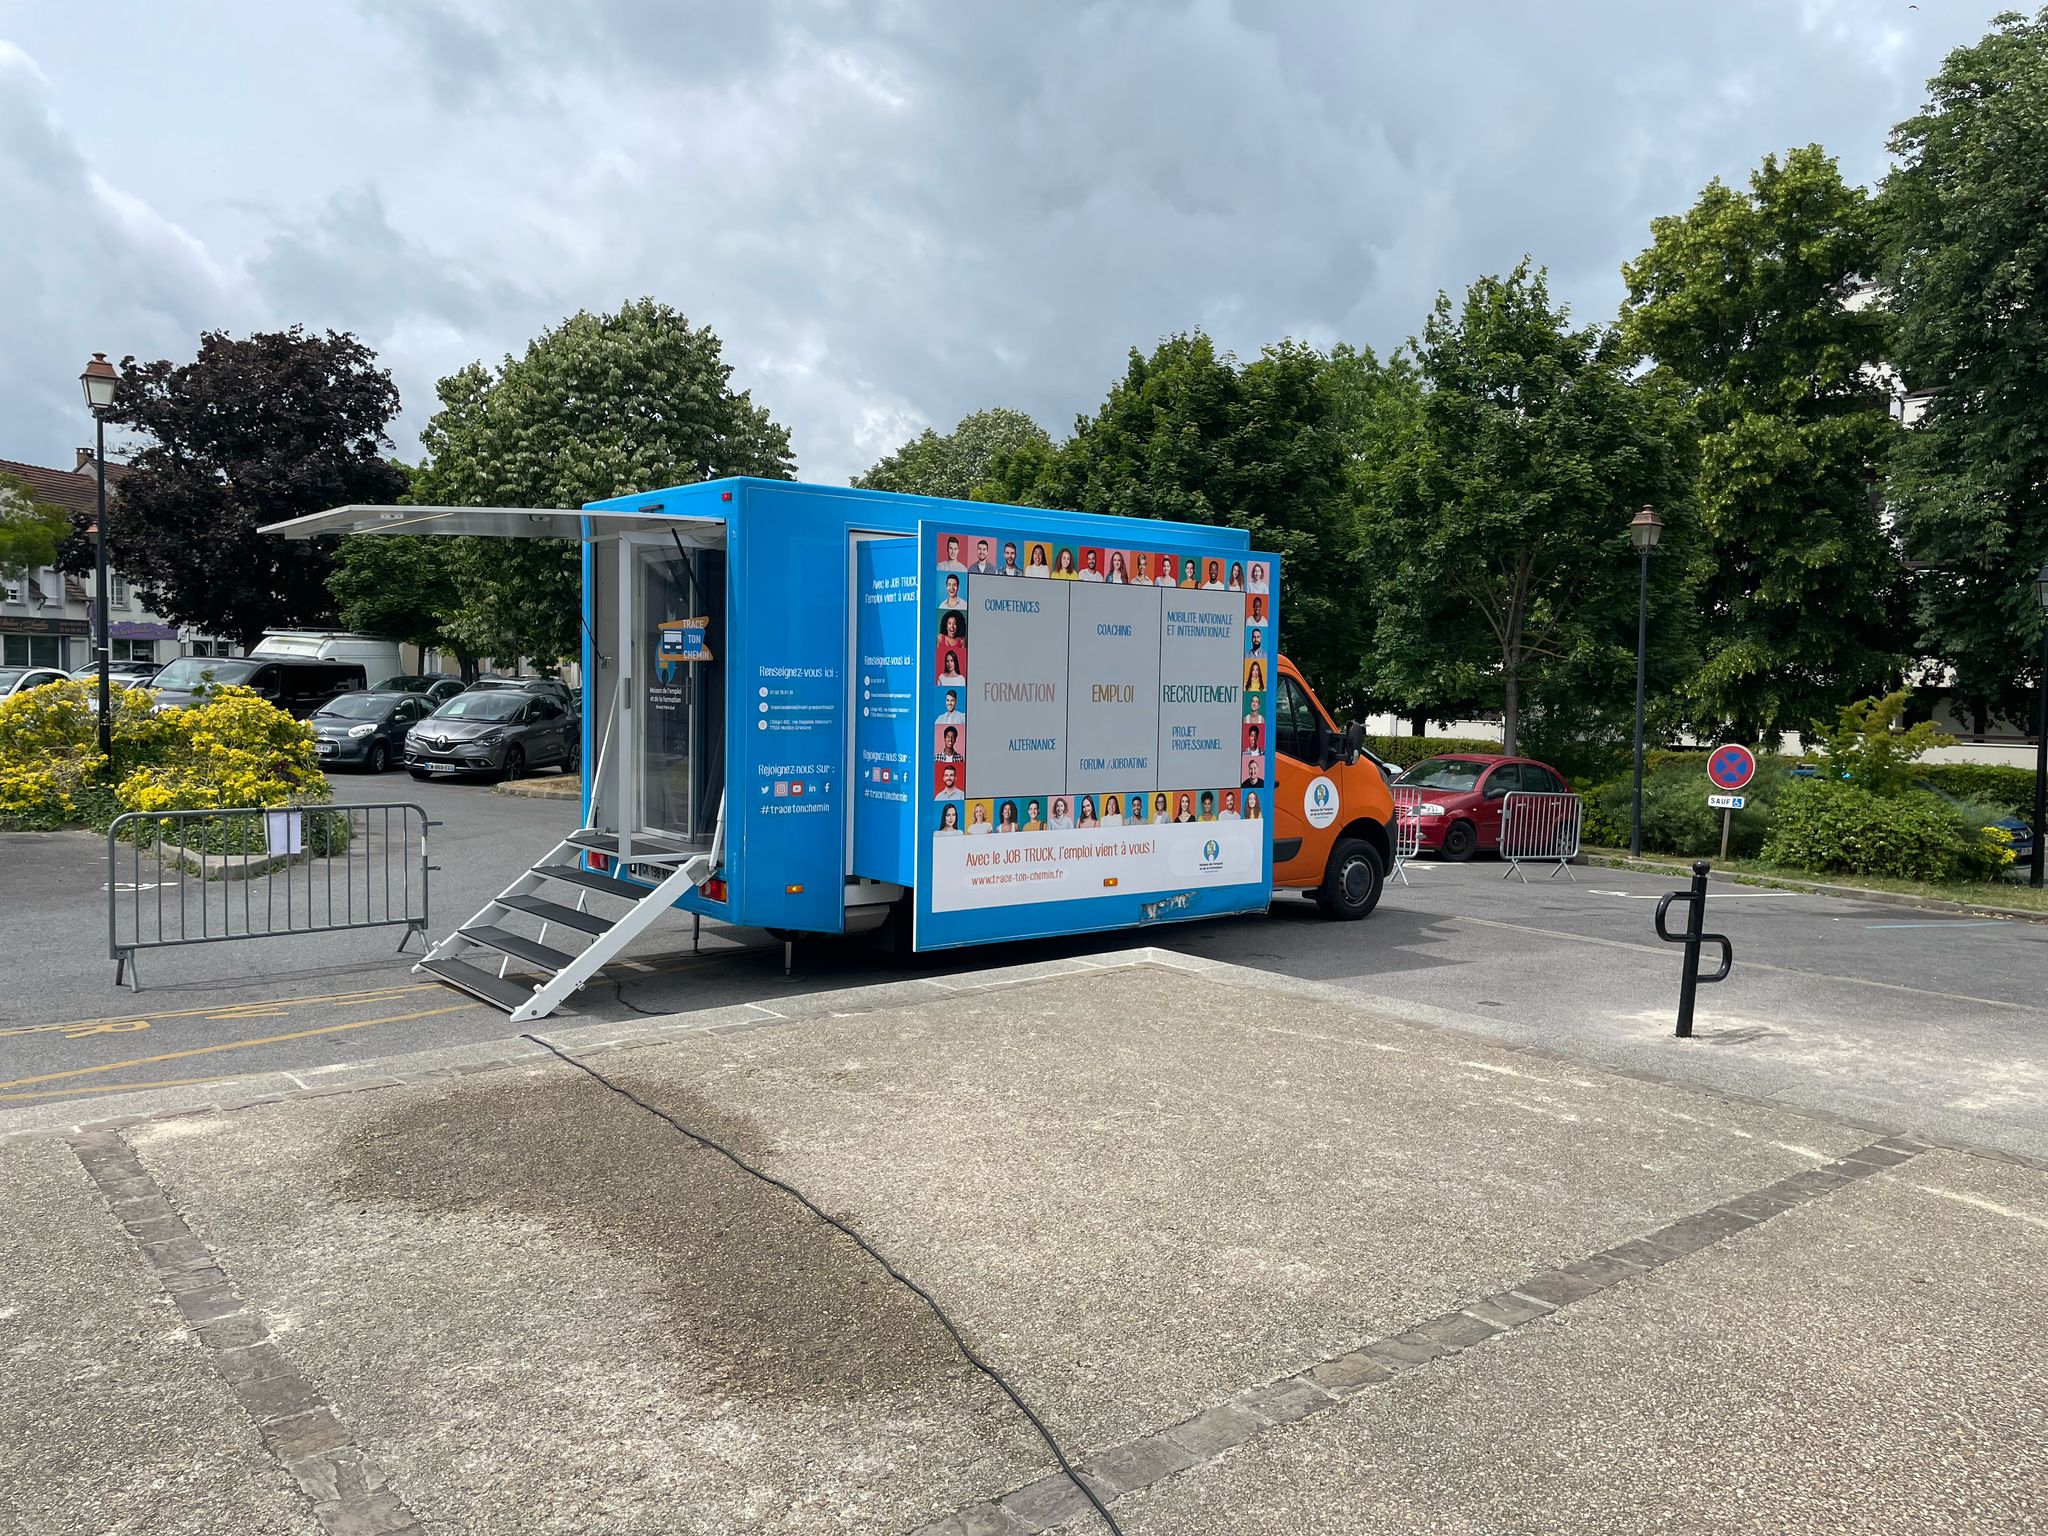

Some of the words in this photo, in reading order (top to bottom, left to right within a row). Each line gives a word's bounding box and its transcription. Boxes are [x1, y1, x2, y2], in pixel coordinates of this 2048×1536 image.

[890, 577, 900, 588] JOB
[902, 591, 916, 601] vous
[984, 599, 1040, 614] COMPETENCES
[683, 620, 704, 629] TRACE
[1167, 611, 1197, 624] MOBILITE
[1199, 613, 1233, 625] NATIONALE
[1097, 623, 1132, 637] COACHING
[1167, 625, 1175, 636] ET
[1177, 625, 1230, 638] INTERNATIONALE
[688, 634, 701, 643] TON
[683, 650, 709, 660] CHEMIN
[760, 665, 822, 679] Renseignez-vous
[824, 667, 834, 677] ici
[984, 683, 1055, 703] FORMATION
[1092, 684, 1134, 703] EMPLOI
[1163, 684, 1238, 703] RECRUTEMENT
[1172, 726, 1196, 738] PROJET
[1009, 738, 1056, 751] ALTERNANCE
[1172, 738, 1222, 750] PROFESSIONNEL
[758, 764, 815, 777] Rejoignez-nous
[816, 764, 831, 774] sur
[1080, 758, 1105, 771] FORUM
[1710, 797, 1731, 805] SAUF
[760, 803, 830, 815] #tracetonchemin
[966, 851, 990, 867] Avec
[992, 851, 1000, 865] le
[1003, 849, 1021, 864] JOB
[1024, 847, 1056, 862] TRUCK,
[1059, 843, 1092, 861] l'emploi
[1096, 843, 1118, 858] vient
[1121, 841, 1127, 855] à
[1129, 841, 1150, 855] vous
[971, 868, 1064, 886] www.trace-ton-chemin.fr
